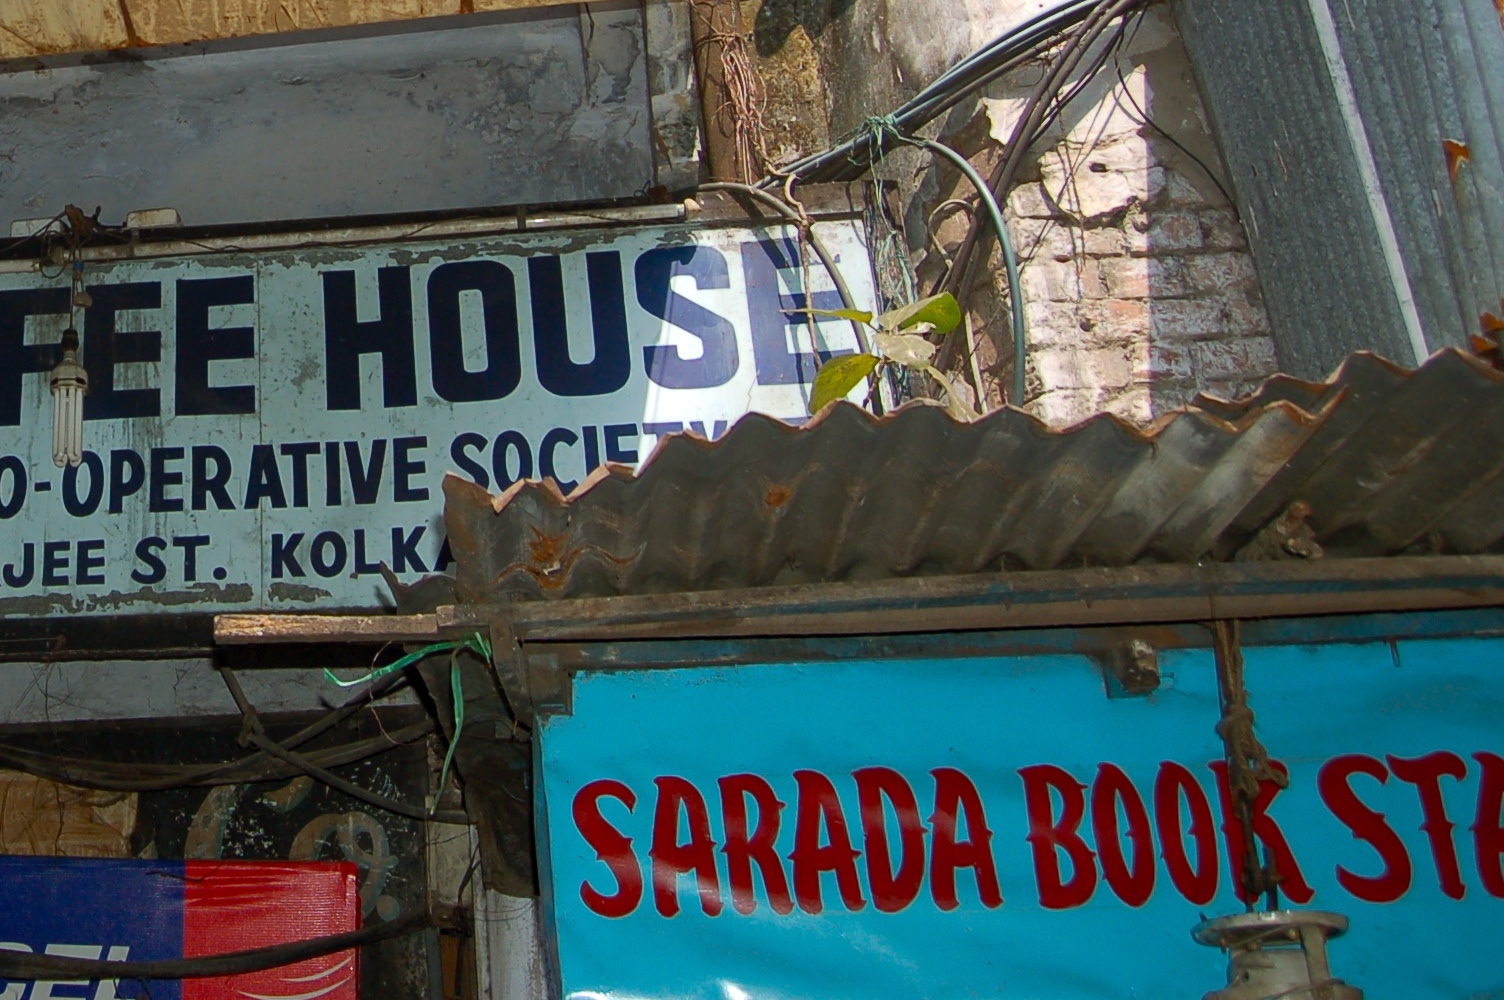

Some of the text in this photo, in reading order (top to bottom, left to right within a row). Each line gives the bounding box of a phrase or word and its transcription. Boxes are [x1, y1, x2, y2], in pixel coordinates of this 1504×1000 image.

[323, 239, 856, 412] HOUSE
[130, 535, 226, 586] ST.
[569, 765, 1003, 920] SARADA
[1017, 759, 1315, 911] BOOK
